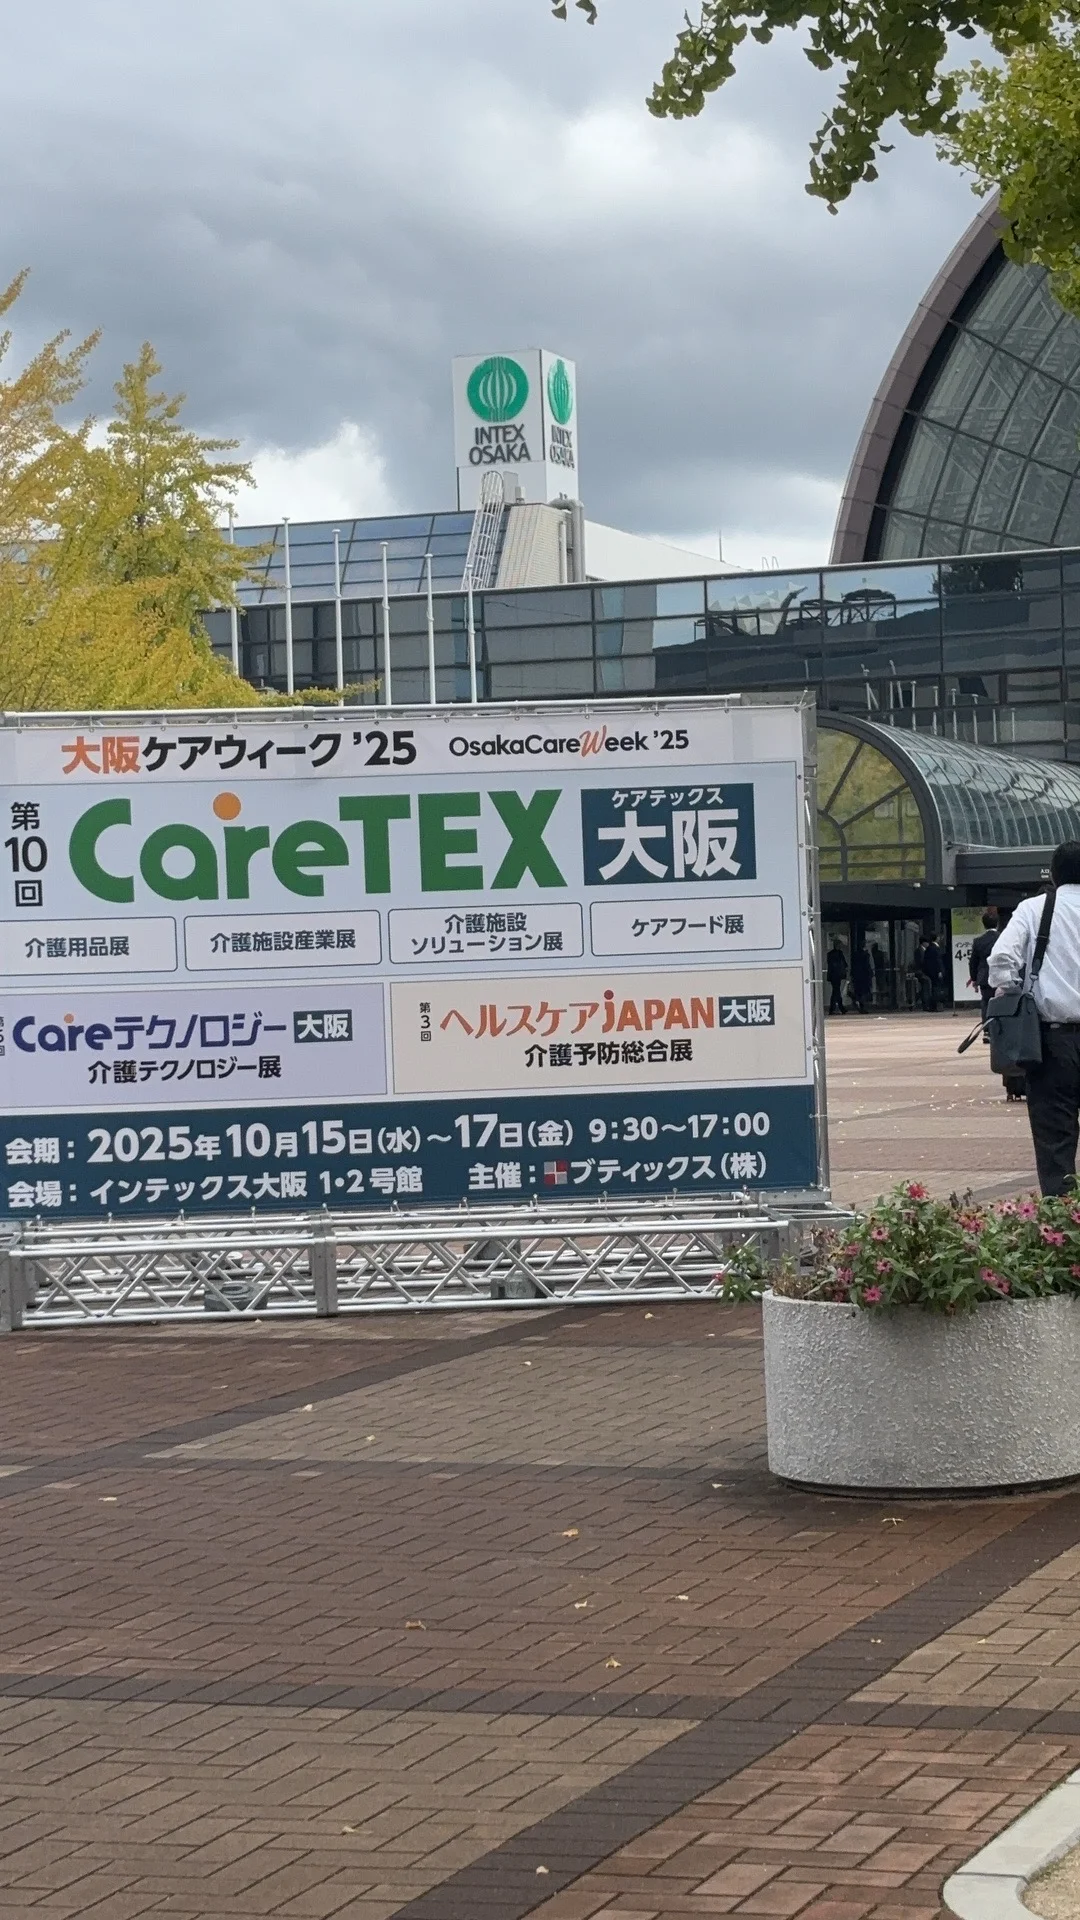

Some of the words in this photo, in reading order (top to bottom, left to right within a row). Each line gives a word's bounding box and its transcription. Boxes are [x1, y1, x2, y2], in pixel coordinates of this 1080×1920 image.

[475, 424, 525, 445] INTEX
[469, 442, 531, 465] OSAKA
[61, 732, 341, 775] 大阪ケアウィーク
[448, 724, 648, 758] OsakaCareWeek
[611, 787, 724, 809] ケアテックス
[69, 789, 568, 904] CareTEX
[598, 807, 742, 881] 大阪
[444, 912, 527, 934] 介護施設
[631, 914, 744, 938] ケアフード展
[25, 936, 130, 959] 介護用品展
[210, 929, 356, 954] 介護施設産業展
[411, 931, 563, 955] ソリューション展
[419, 1001, 432, 1042] 第3回
[722, 999, 772, 1025] 大阪
[296, 1014, 349, 1040] 大阪
[524, 1038, 693, 1068] 介護予防総合展
[88, 1055, 282, 1085] 介護テクノロジー展
